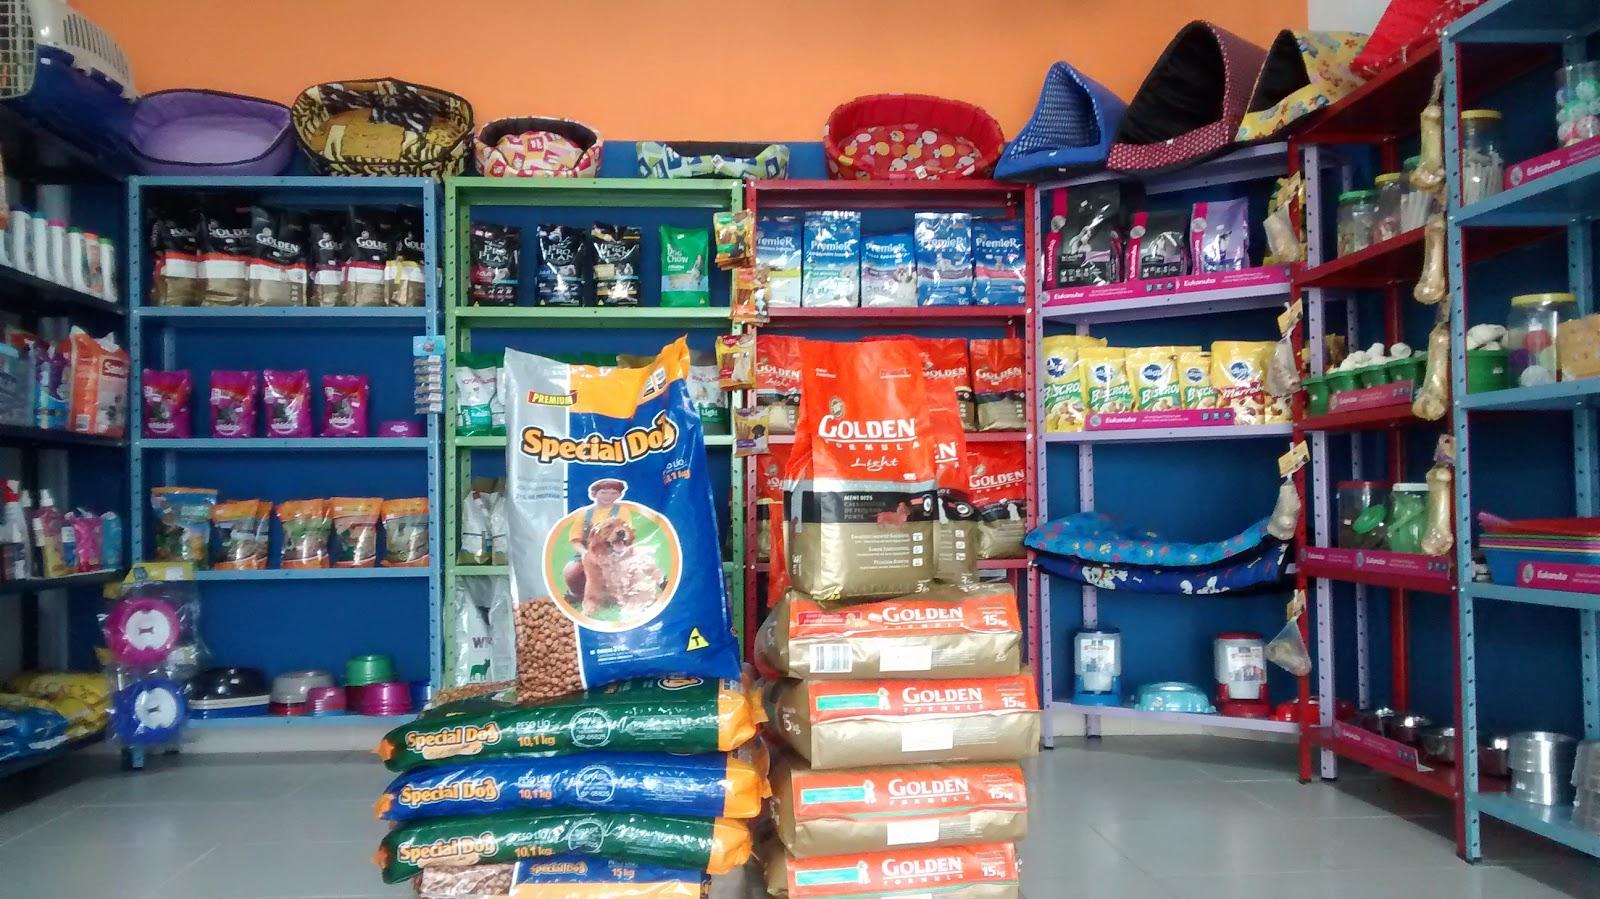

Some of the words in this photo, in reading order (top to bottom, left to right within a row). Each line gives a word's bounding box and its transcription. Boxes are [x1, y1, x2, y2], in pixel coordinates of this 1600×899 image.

[256, 233, 299, 253] GOLDEN
[404, 237, 425, 249] GOLD
[757, 236, 795, 248] remieR
[532, 392, 573, 405] PREMIUM
[818, 414, 916, 439] GOLDEN
[522, 427, 626, 464] Special
[625, 411, 677, 459] Dog
[850, 455, 899, 472] Light
[969, 469, 1025, 487] GOLDEN
[882, 607, 964, 623] GOLDEN
[902, 687, 983, 703] GOLDEN
[406, 728, 462, 749] Special
[464, 723, 500, 744] Dog
[541, 735, 556, 746] kg
[400, 786, 460, 808] Special
[462, 777, 499, 801] Dog
[888, 778, 969, 797] GOLDEN
[398, 841, 458, 865] Special
[459, 832, 498, 856] Dog
[881, 857, 962, 876] GOLDEN
